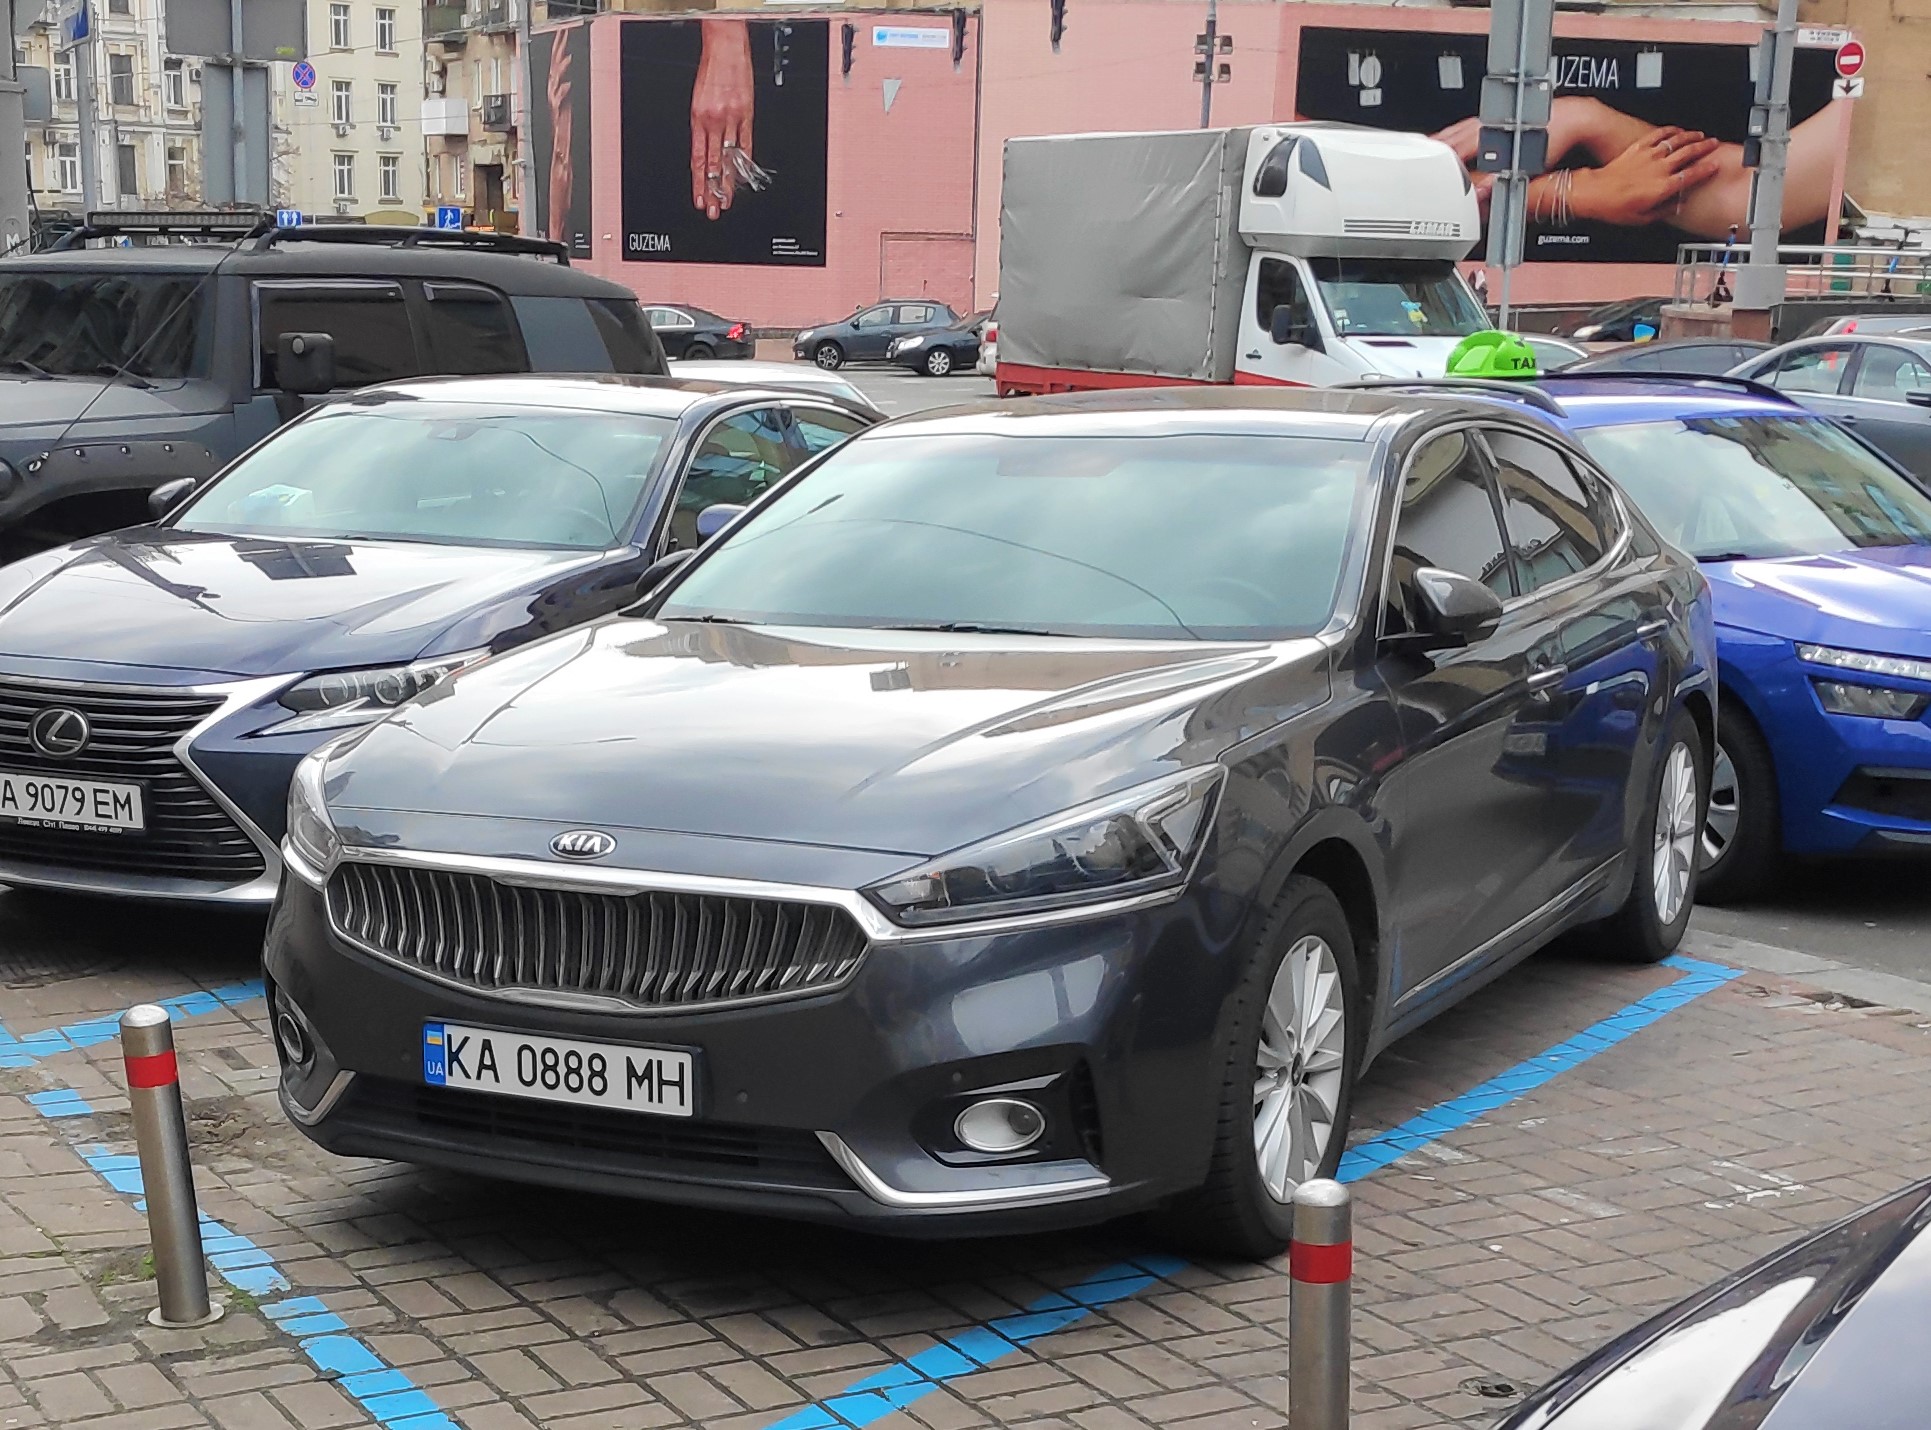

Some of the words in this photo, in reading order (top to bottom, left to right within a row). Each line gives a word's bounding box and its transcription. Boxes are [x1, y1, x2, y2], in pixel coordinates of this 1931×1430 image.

[629, 233, 671, 251] GUZEMA
[1537, 235, 1590, 245] guzema.com
[25, 781, 86, 816] 9079
[93, 787, 133, 822] EM
[557, 834, 602, 853] KIA
[427, 1060, 444, 1076] UA
[447, 1033, 500, 1083] KA
[516, 1043, 608, 1096] 0888
[625, 1056, 685, 1106] MH
